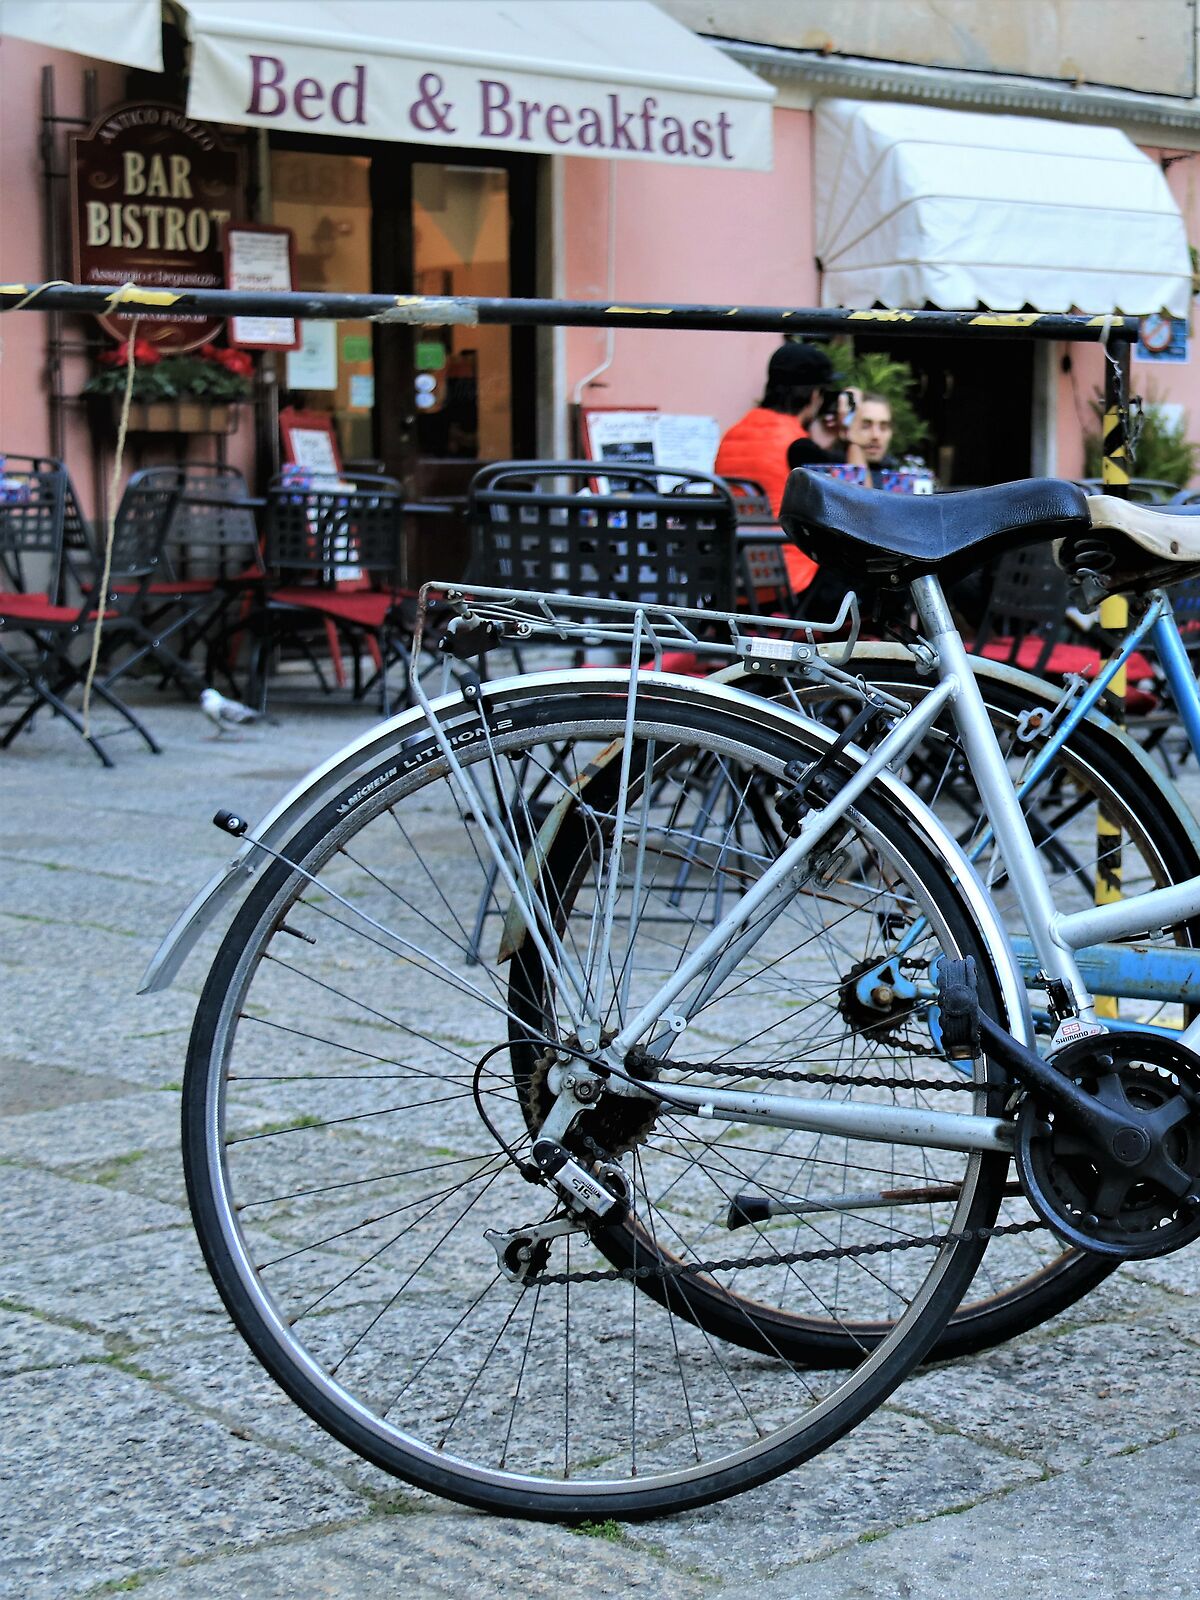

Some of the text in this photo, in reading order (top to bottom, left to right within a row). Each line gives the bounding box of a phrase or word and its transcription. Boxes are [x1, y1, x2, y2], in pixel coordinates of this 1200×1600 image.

[245, 55, 735, 161] Bed & Breakfast
[123, 151, 193, 199] BAR
[346, 766, 398, 805] MICHELIN
[1055, 1030, 1089, 1045] SHIMANO
[1062, 1023, 1080, 1035] SIS
[572, 1178, 592, 1200] SIS
